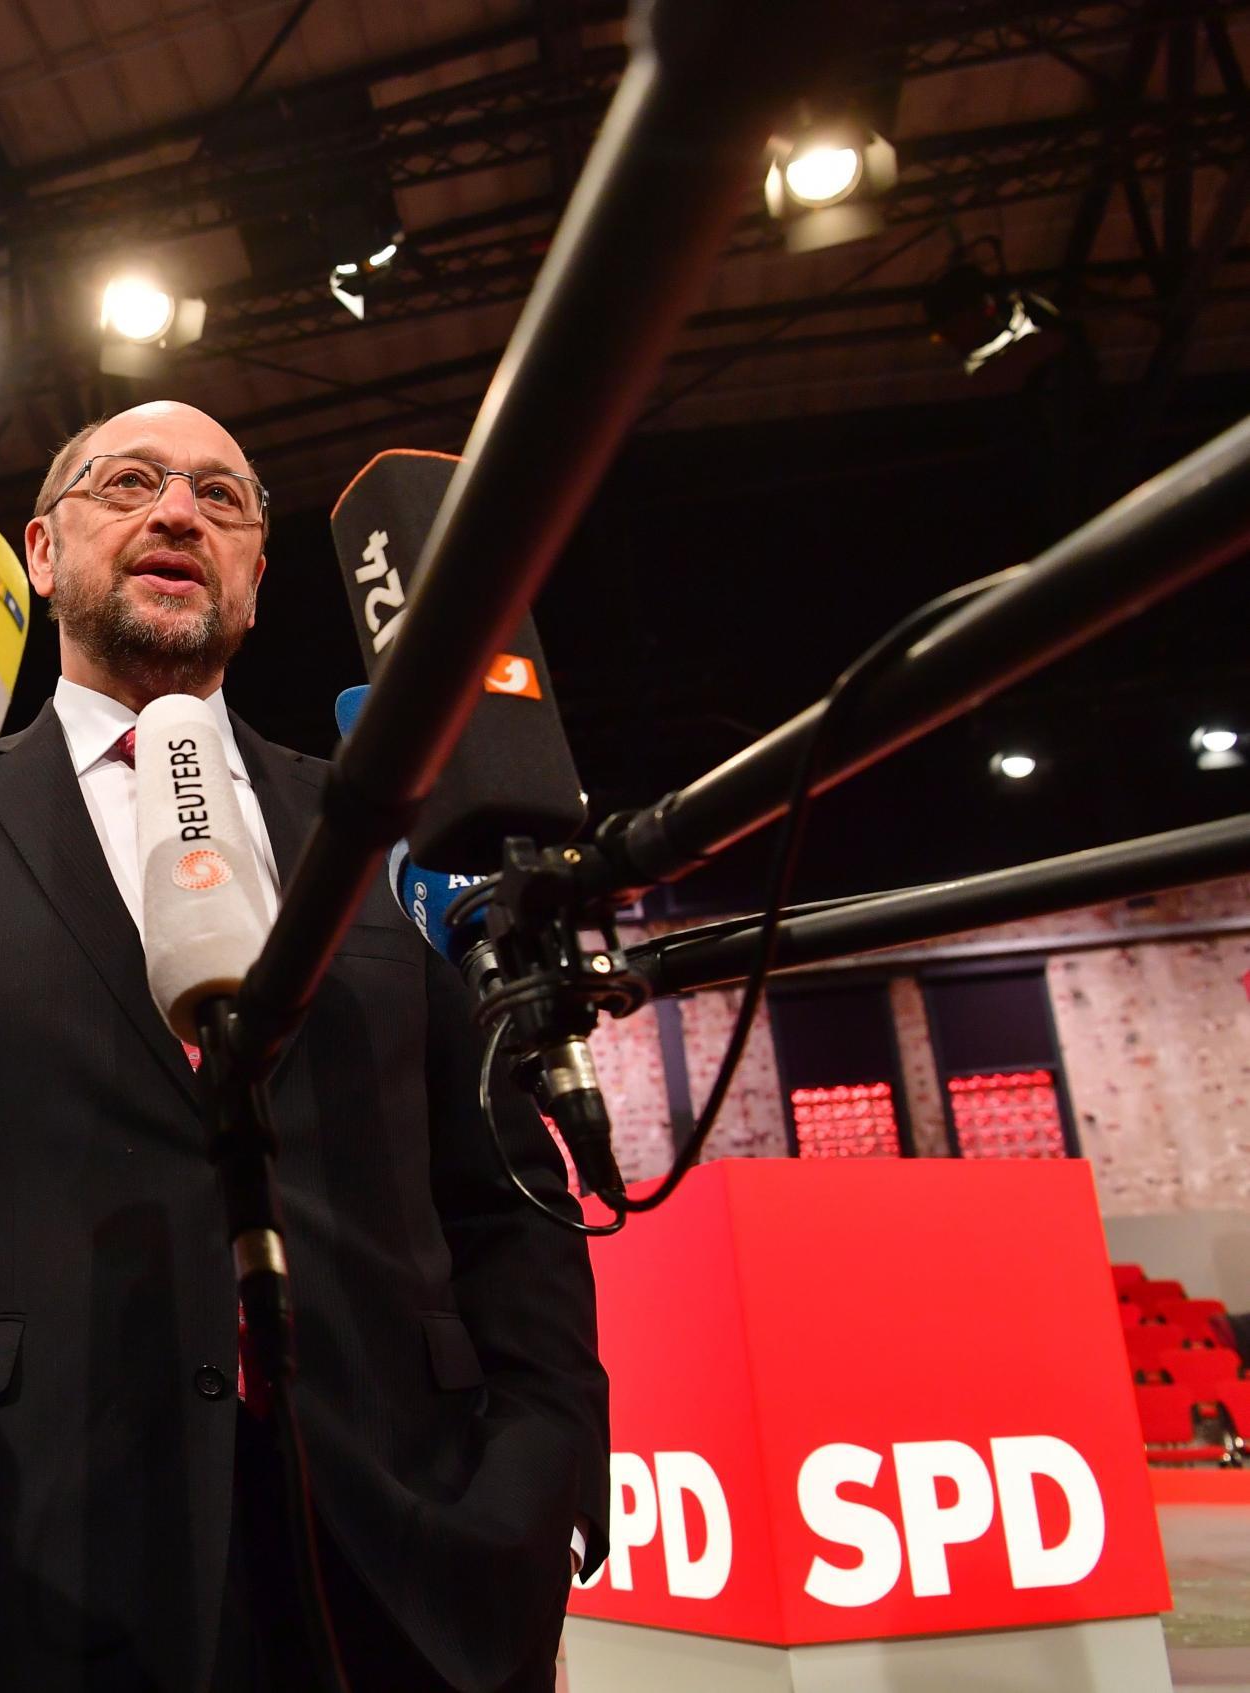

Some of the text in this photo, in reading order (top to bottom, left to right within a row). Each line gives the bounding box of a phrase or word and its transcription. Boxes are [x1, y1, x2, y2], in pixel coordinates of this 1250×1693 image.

[168, 738, 212, 842] REUTERS
[572, 1451, 733, 1600] PD
[797, 1435, 1106, 1608] SPD
